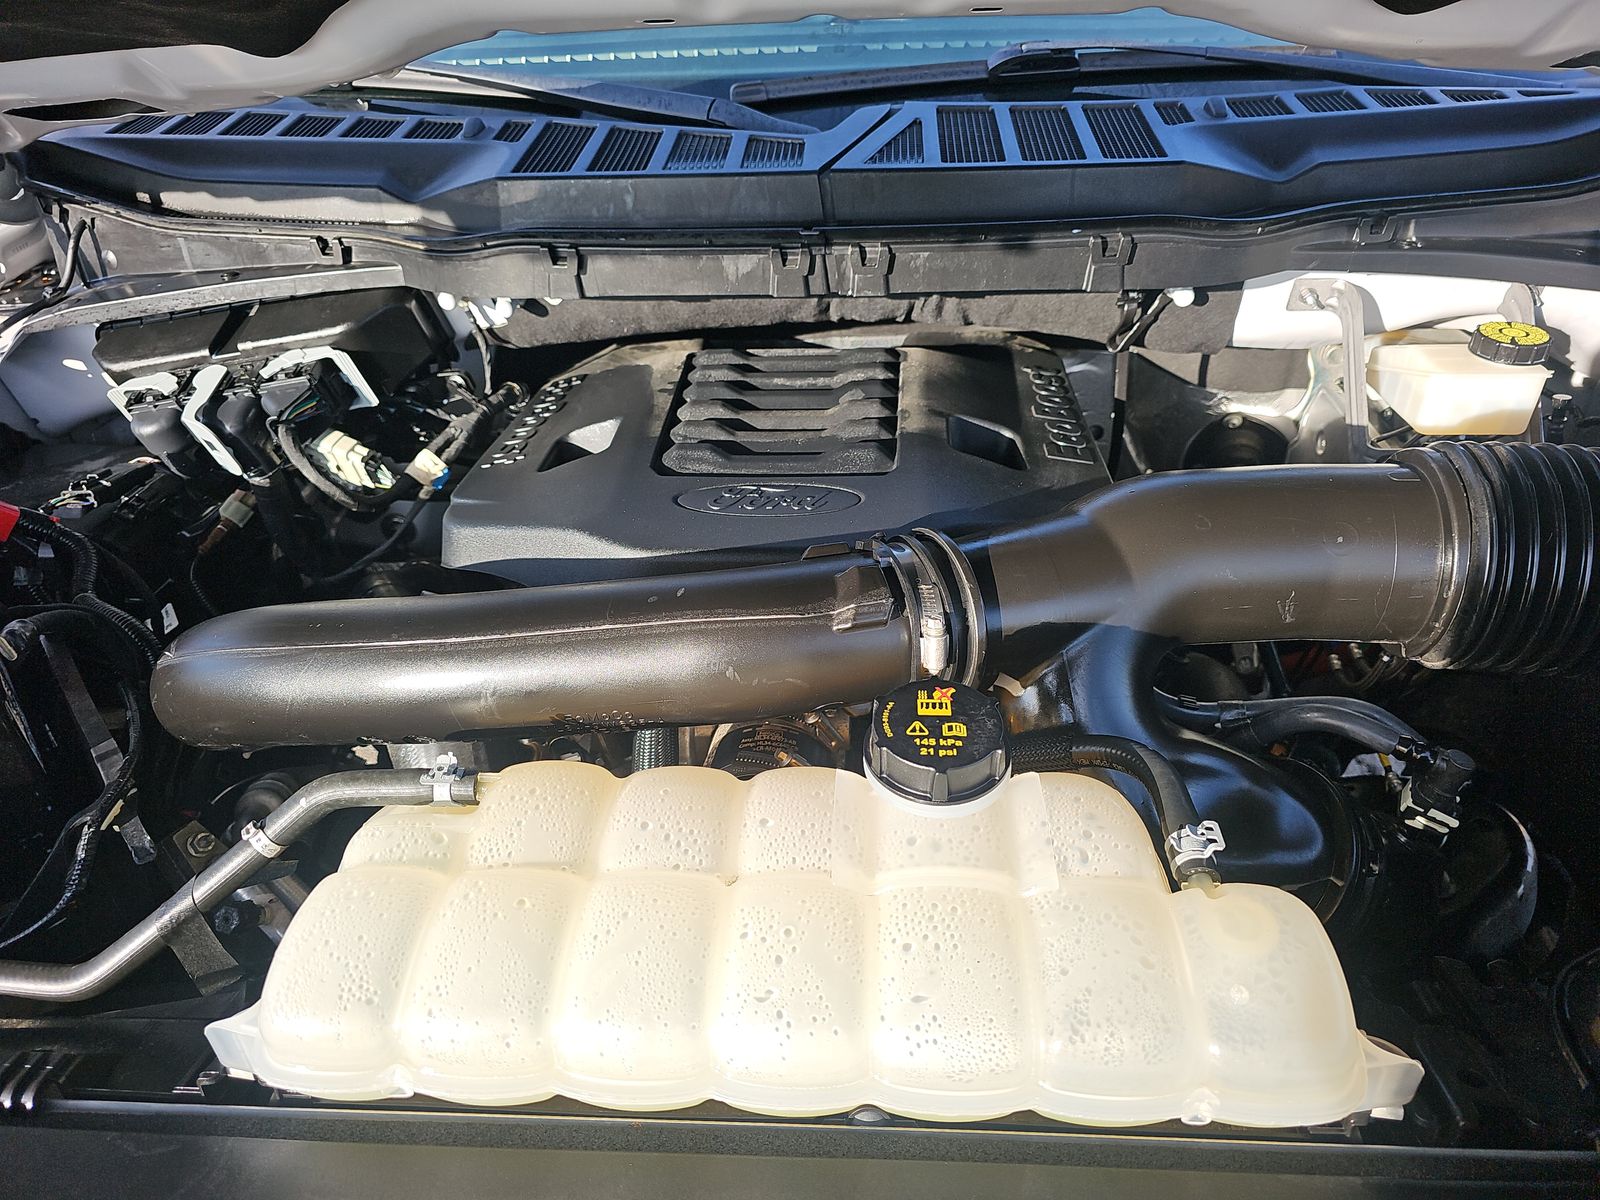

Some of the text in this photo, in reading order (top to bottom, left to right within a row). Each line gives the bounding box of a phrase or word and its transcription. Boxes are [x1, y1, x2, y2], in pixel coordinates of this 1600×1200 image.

[1029, 365, 1095, 465] EcoBoost
[707, 484, 832, 510] Ford
[913, 738, 963, 747] 145 kPa
[919, 747, 958, 758] 21 psi
